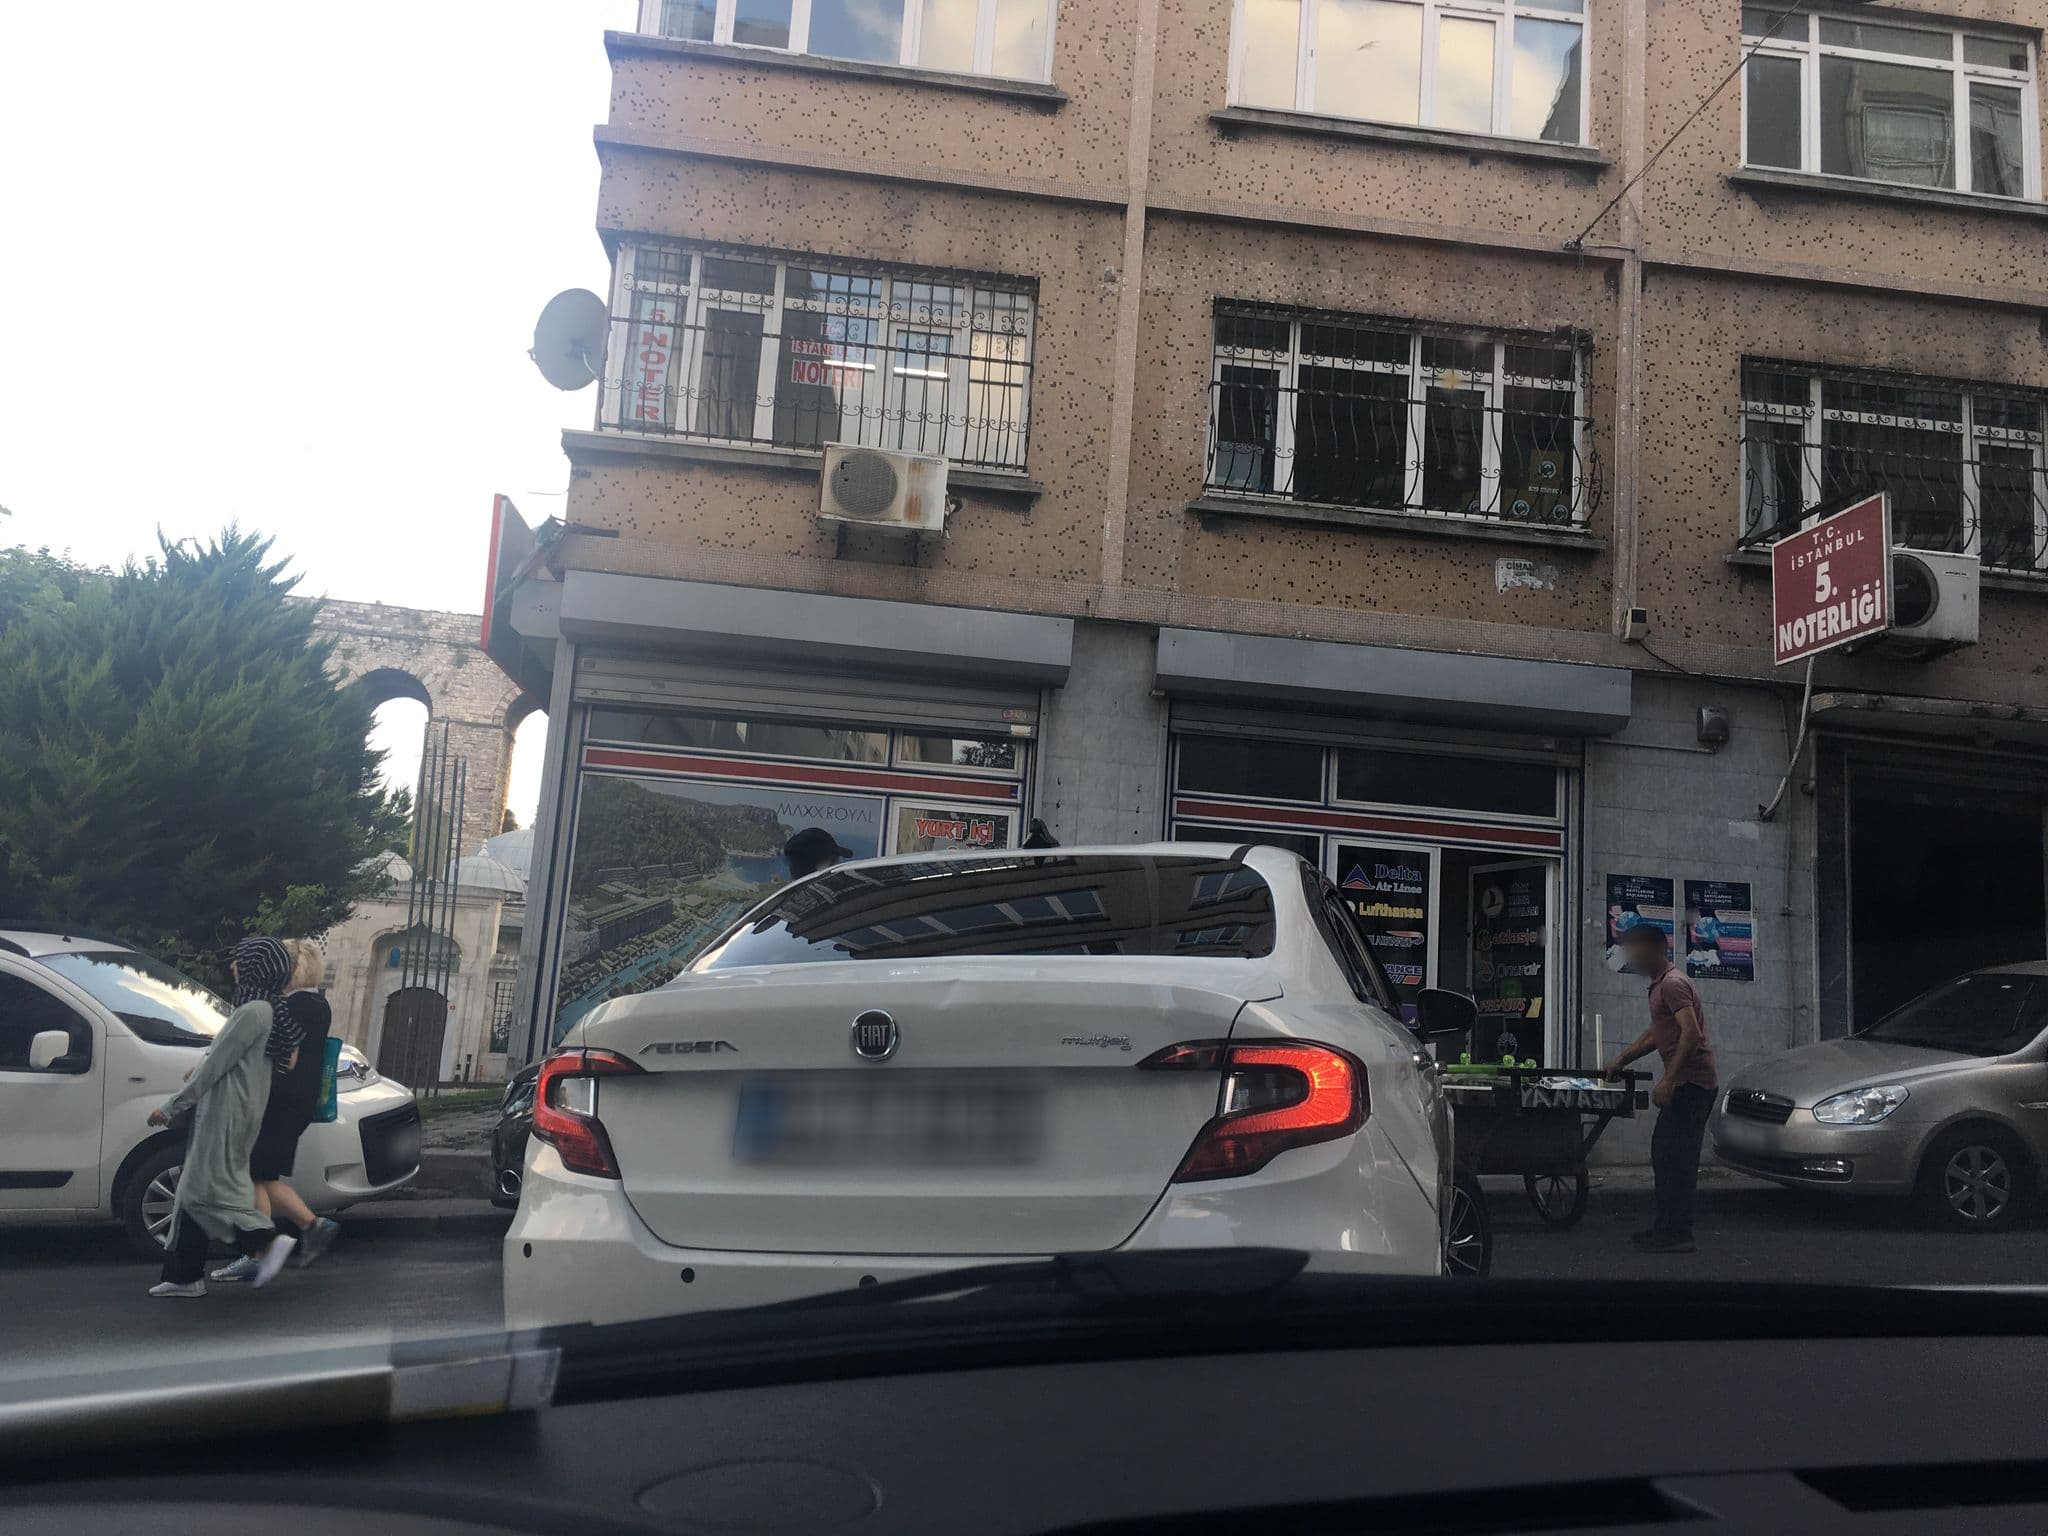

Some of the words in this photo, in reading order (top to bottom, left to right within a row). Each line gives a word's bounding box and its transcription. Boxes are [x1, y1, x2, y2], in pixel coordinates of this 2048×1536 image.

[1812, 526, 1841, 545] T.C.
[1791, 529, 1865, 571] İSTANBUL
[1815, 561, 1838, 603] 5.
[1779, 579, 1881, 653] NOTERLİĞİ
[915, 818, 967, 840] YURT
[1375, 863, 1422, 881] Delta
[1376, 881, 1393, 892] Air
[1393, 882, 1423, 894] Lines
[1359, 901, 1424, 919] Lufthansa
[861, 1025, 889, 1047] FIAT
